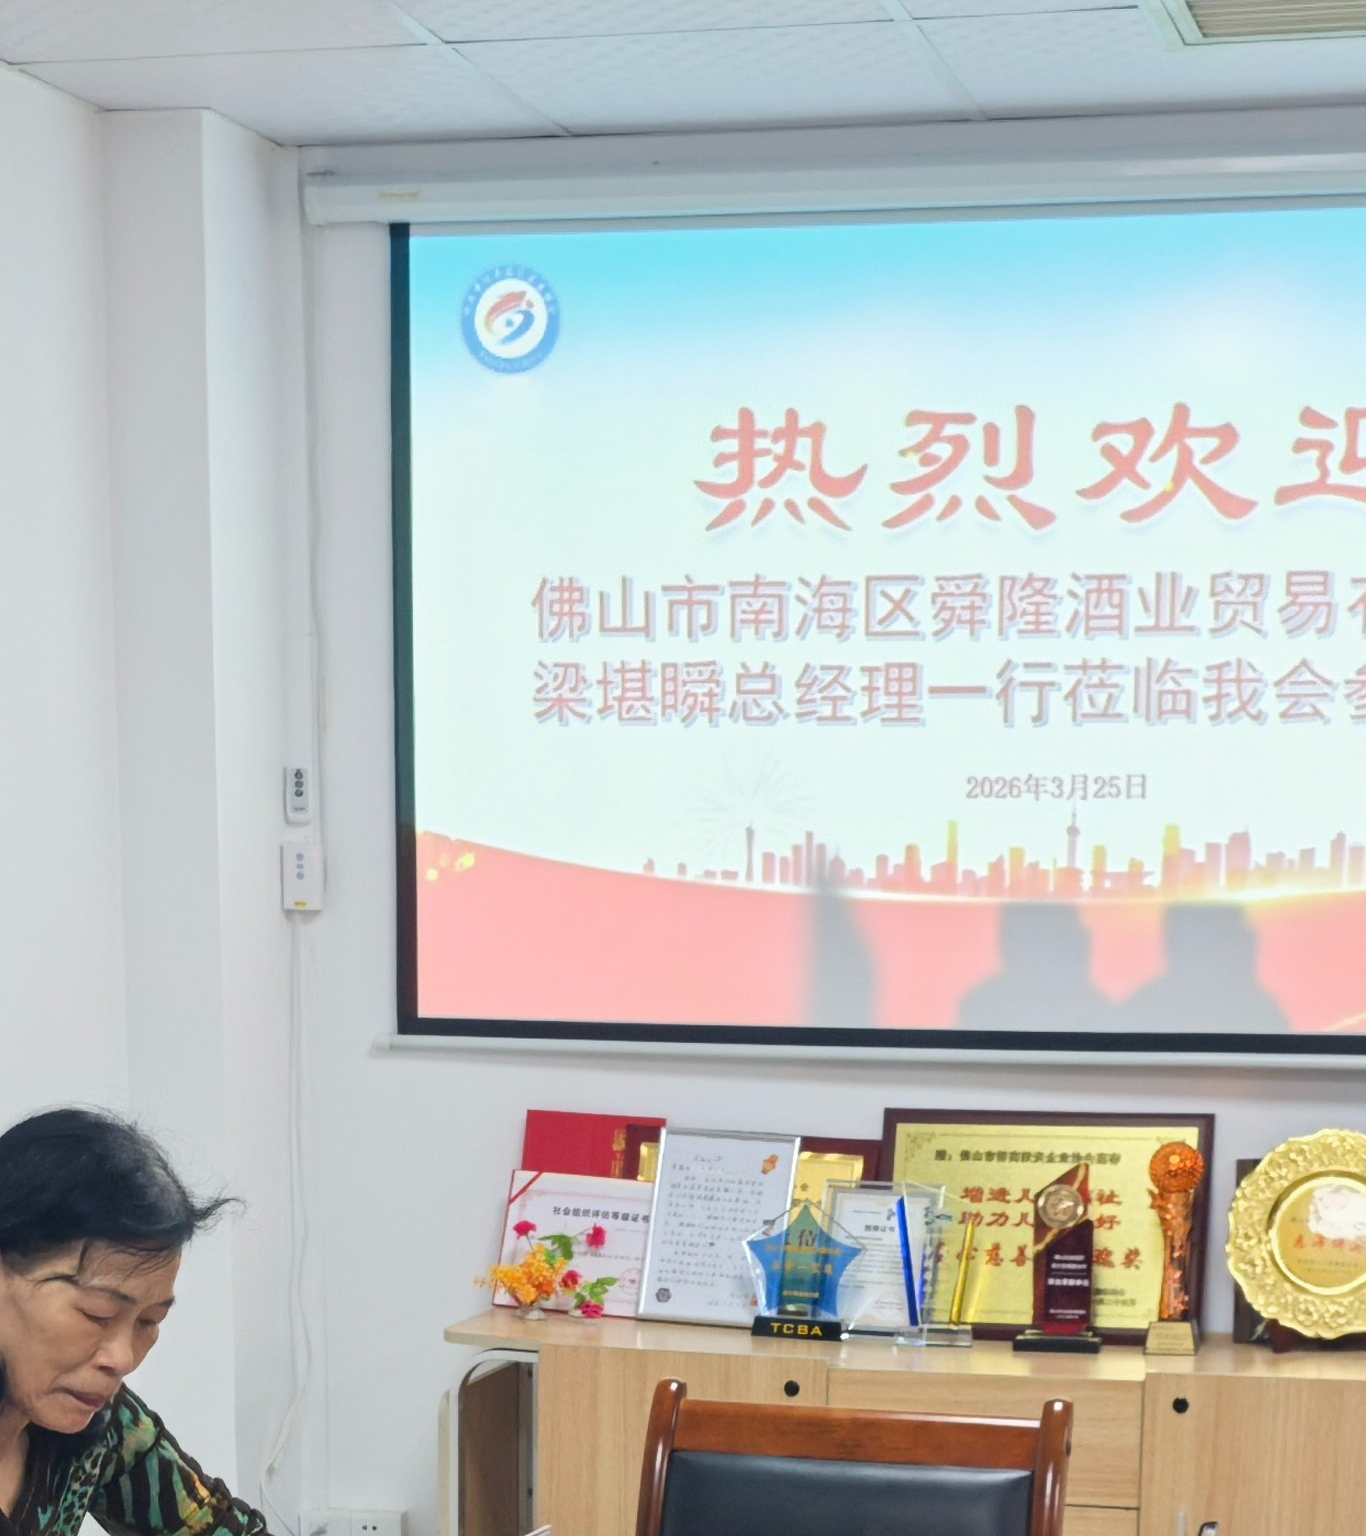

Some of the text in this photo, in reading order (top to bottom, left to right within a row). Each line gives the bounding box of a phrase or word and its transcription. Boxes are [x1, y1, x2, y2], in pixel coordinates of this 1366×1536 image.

[965, 772, 1149, 803] 2026年3月25日
[770, 1322, 823, 1336] TCBA
